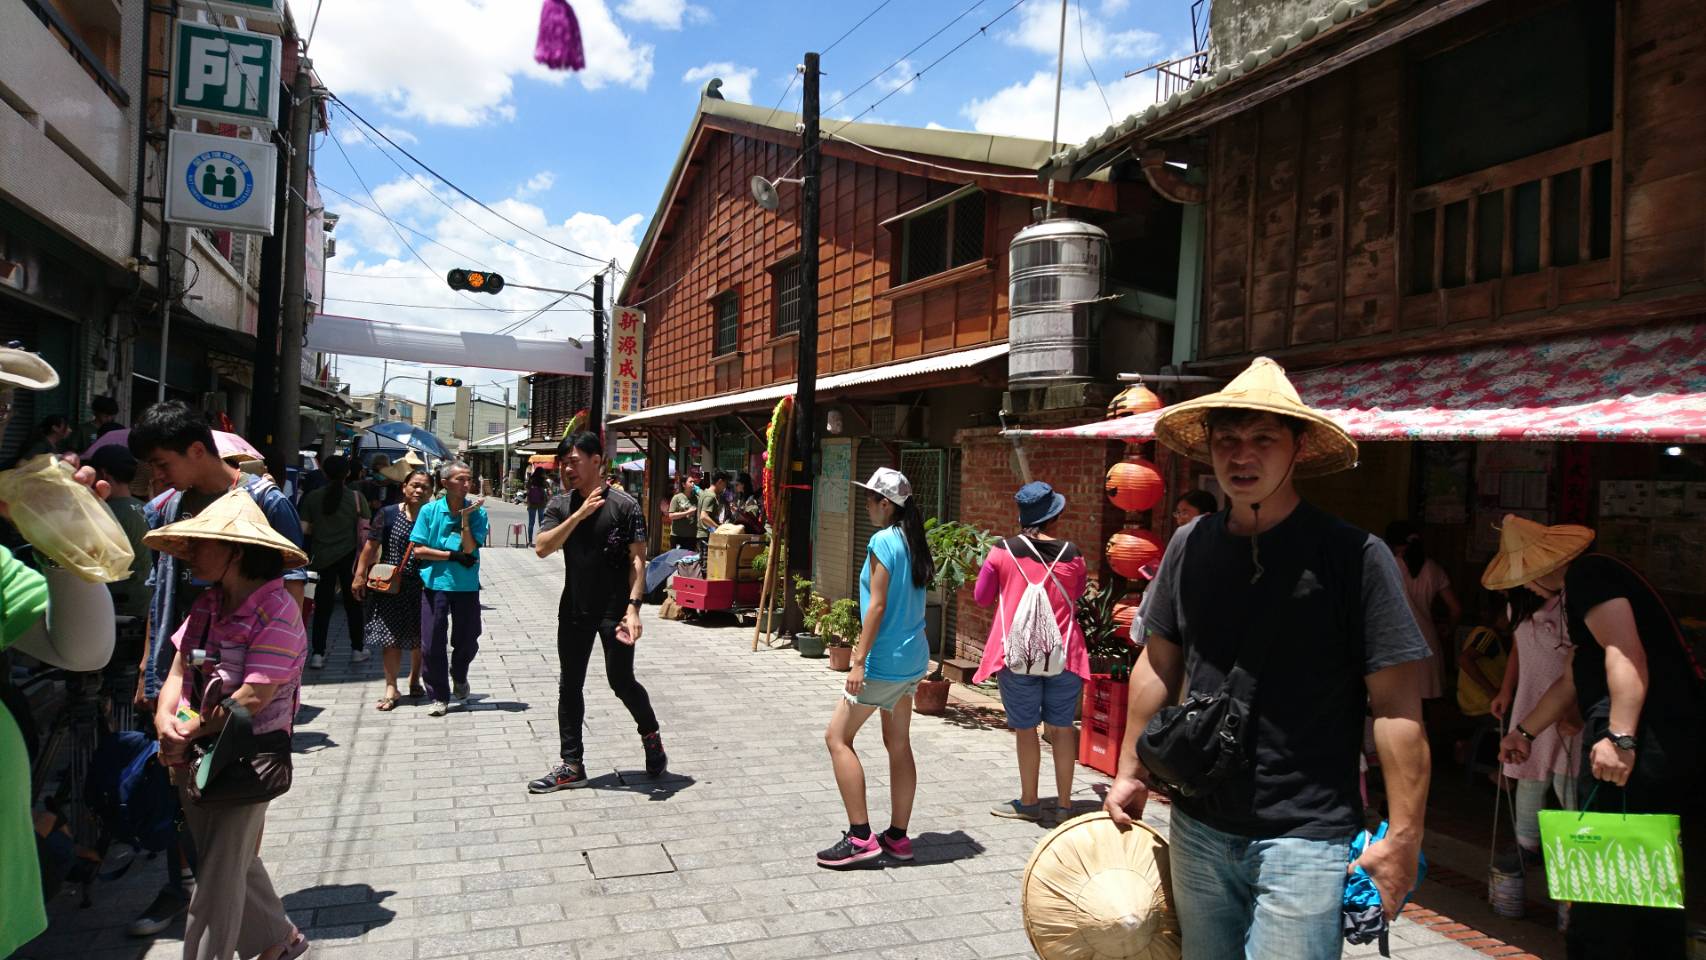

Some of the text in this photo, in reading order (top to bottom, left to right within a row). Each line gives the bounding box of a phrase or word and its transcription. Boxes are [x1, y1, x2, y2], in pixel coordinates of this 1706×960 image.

[185, 36, 264, 111] 所
[618, 311, 639, 380] 新源成
